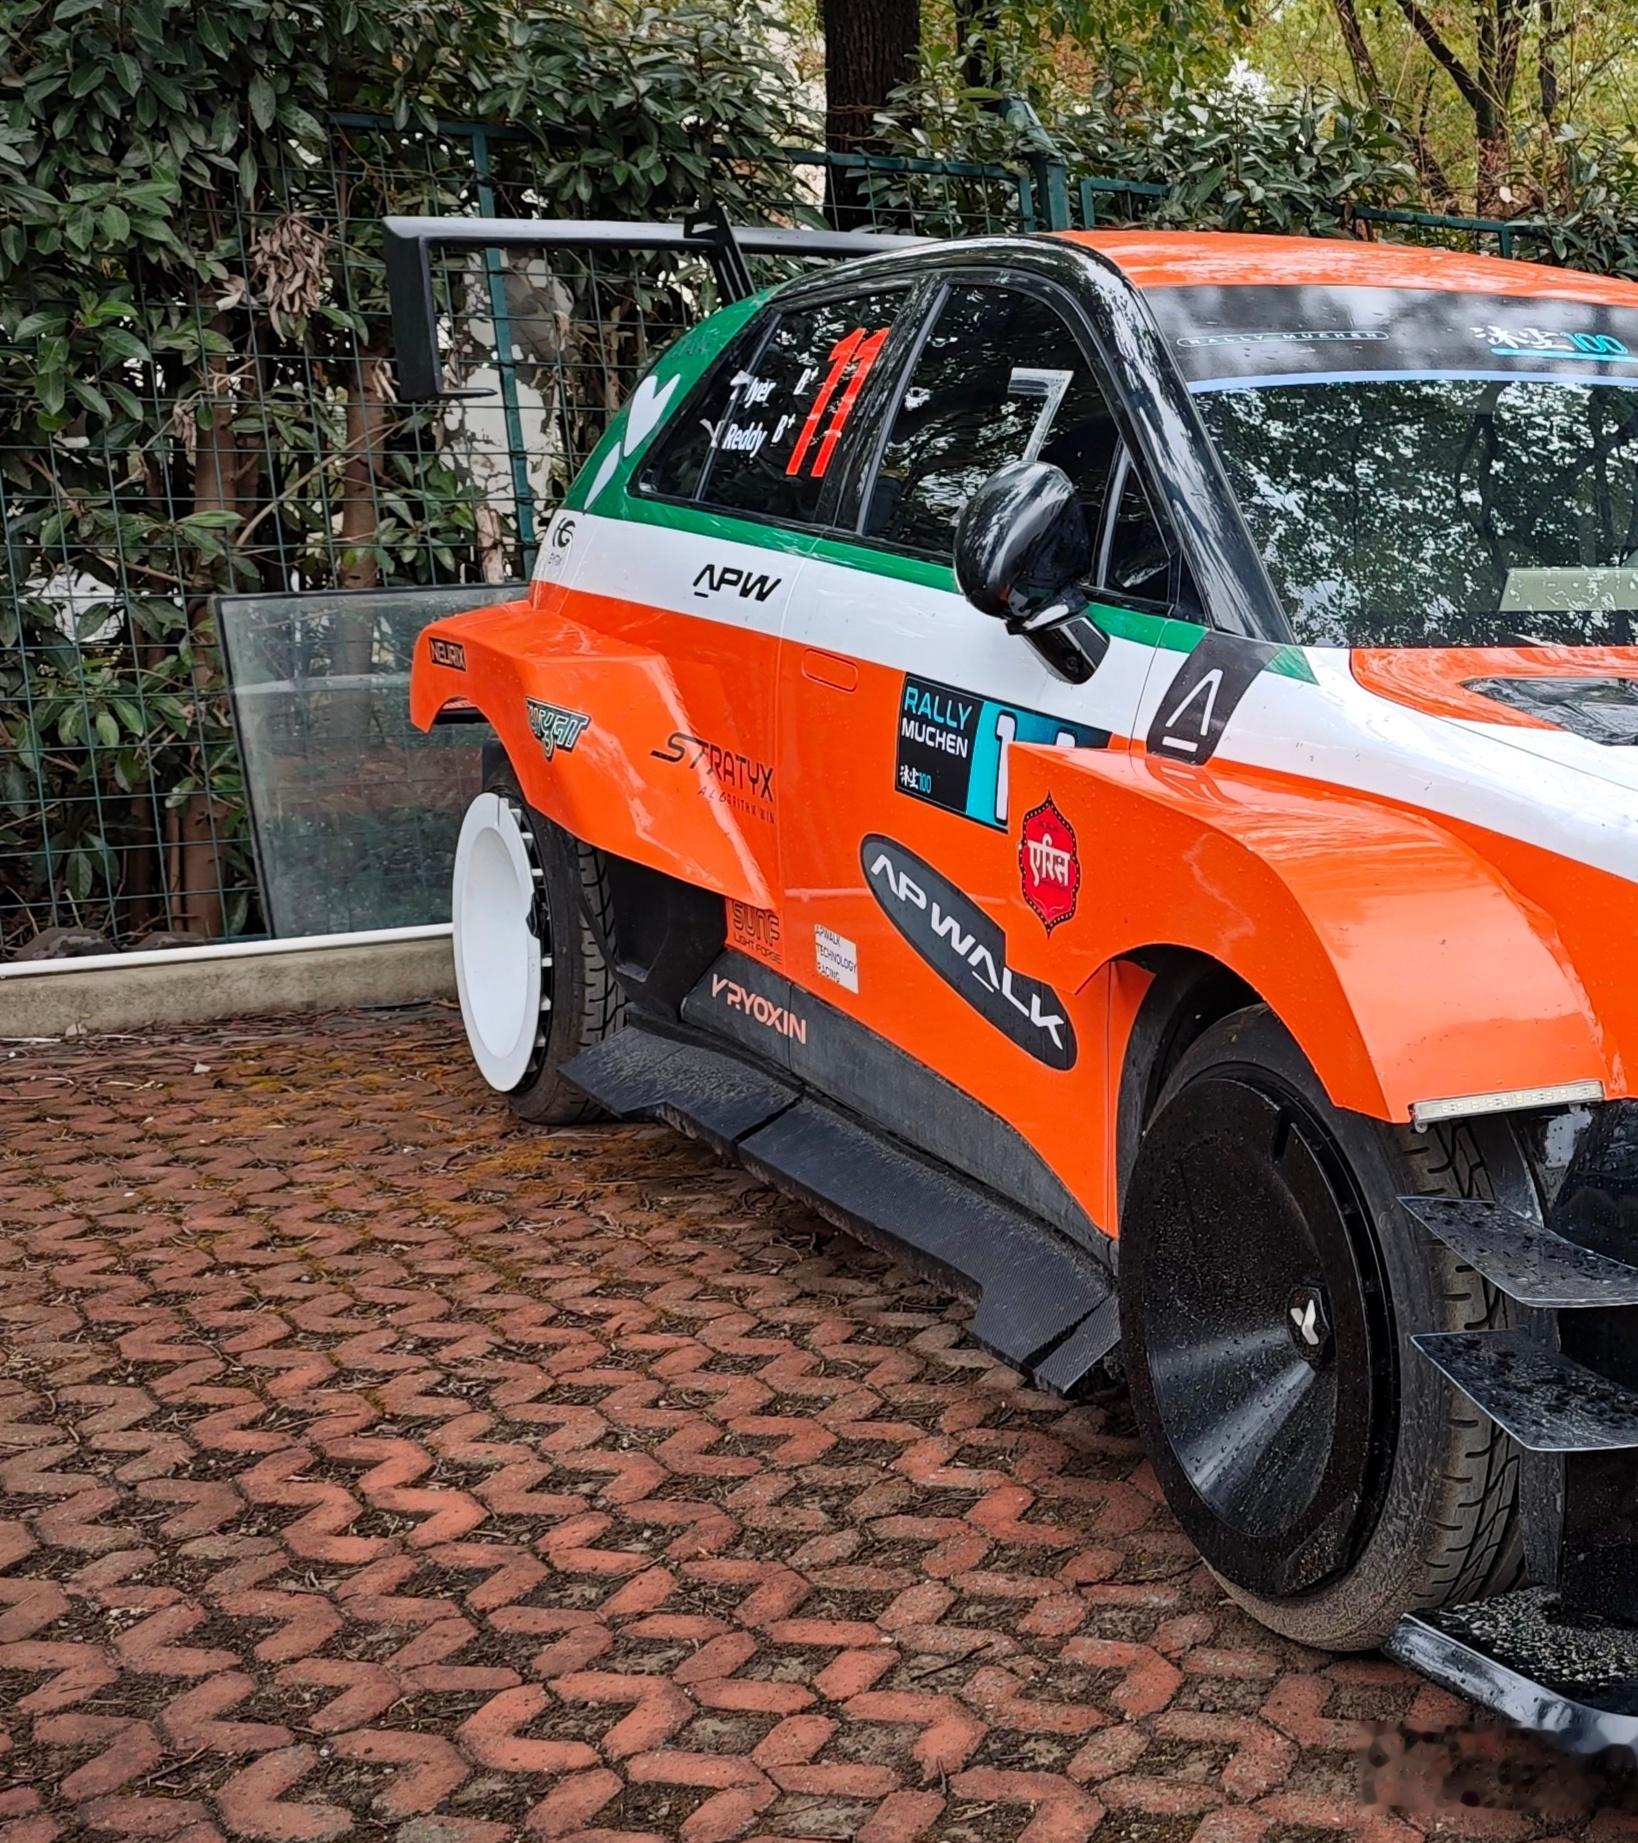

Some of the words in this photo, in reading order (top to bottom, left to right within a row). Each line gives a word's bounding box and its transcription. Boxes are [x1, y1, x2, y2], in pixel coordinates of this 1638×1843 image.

[1188, 333, 1265, 346] RALLY
[1281, 331, 1380, 341] MUCHEN
[785, 326, 891, 477] 11
[721, 421, 768, 458] Reddy
[903, 686, 973, 731] RALLY
[901, 717, 969, 758] MUCHEN
[650, 731, 774, 803] STRATYX
[816, 941, 857, 974] TECHNOLOGY
[870, 853, 1065, 1051] APWALK
